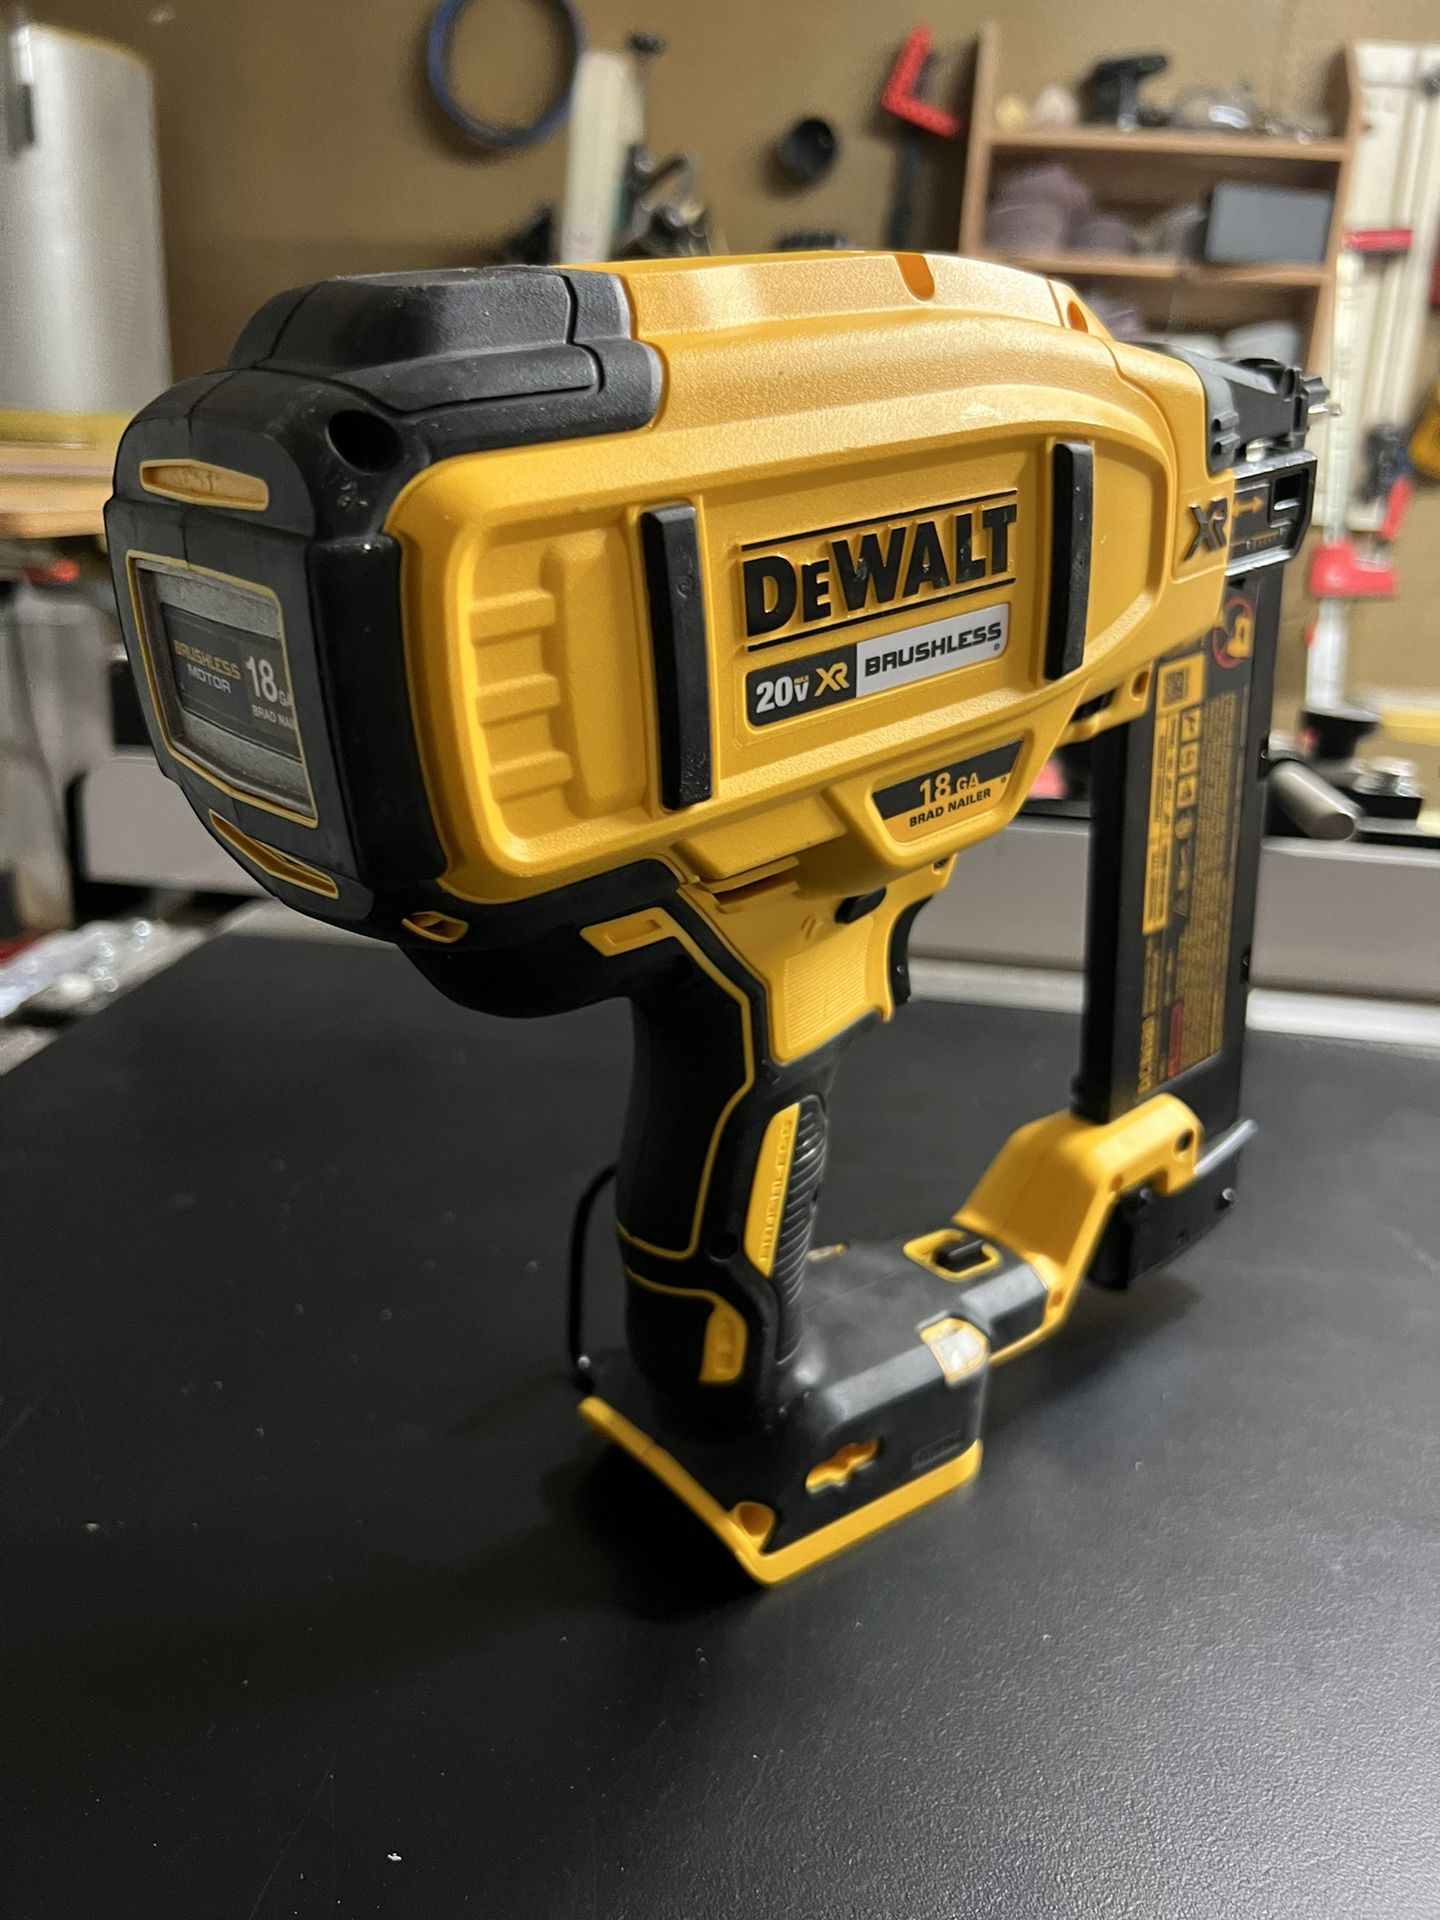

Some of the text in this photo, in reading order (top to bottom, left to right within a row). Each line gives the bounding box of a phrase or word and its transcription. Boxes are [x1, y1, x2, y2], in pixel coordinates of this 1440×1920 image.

[173, 639, 241, 680] BRUSHLESS
[864, 622, 1002, 677] BRUSHLESS
[187, 663, 232, 694] MOTOR
[245, 655, 278, 703] 18
[814, 662, 850, 697] XR
[251, 704, 278, 723] BRAD
[919, 772, 980, 806] 18 GA
[909, 788, 991, 828] BRAD NAILER
